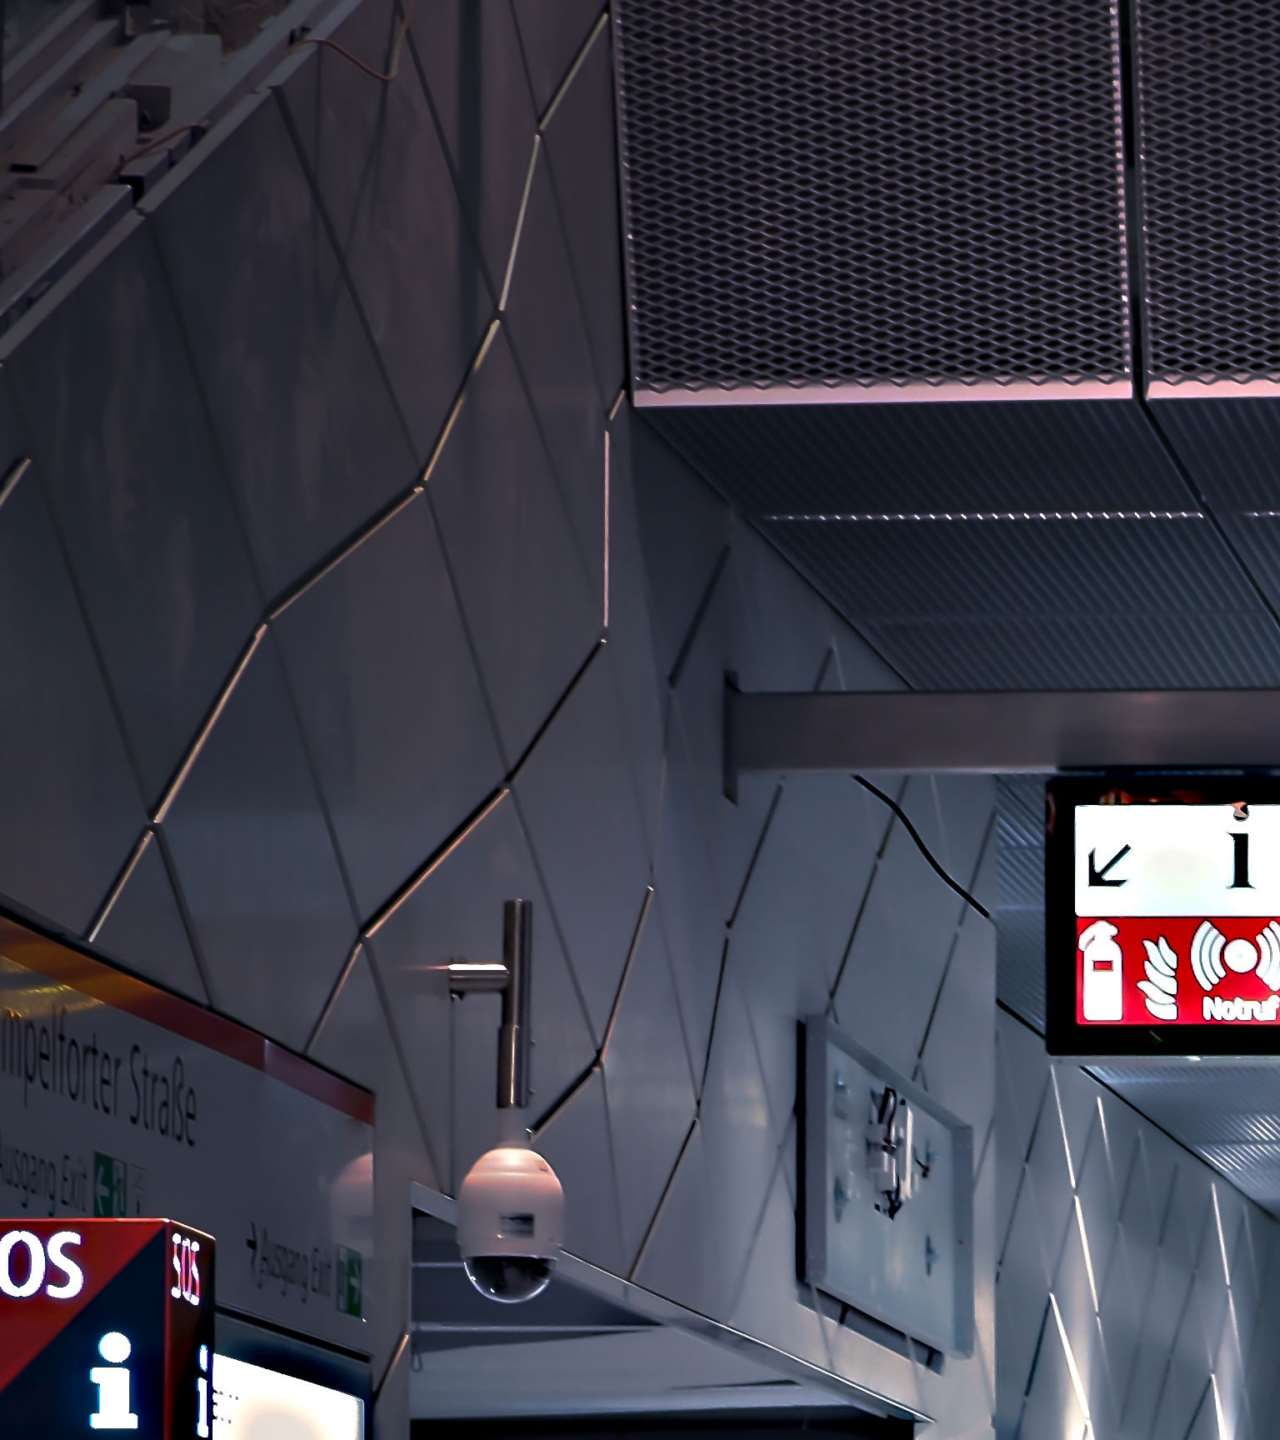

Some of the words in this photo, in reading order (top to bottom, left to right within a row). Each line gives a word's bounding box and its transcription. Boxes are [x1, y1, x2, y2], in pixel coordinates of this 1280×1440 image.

[1202, 994, 1280, 1022] Notruf
[130, 1044, 196, 1146] Straße
[61, 1154, 87, 1213] Exit
[170, 1232, 201, 1305] SOS
